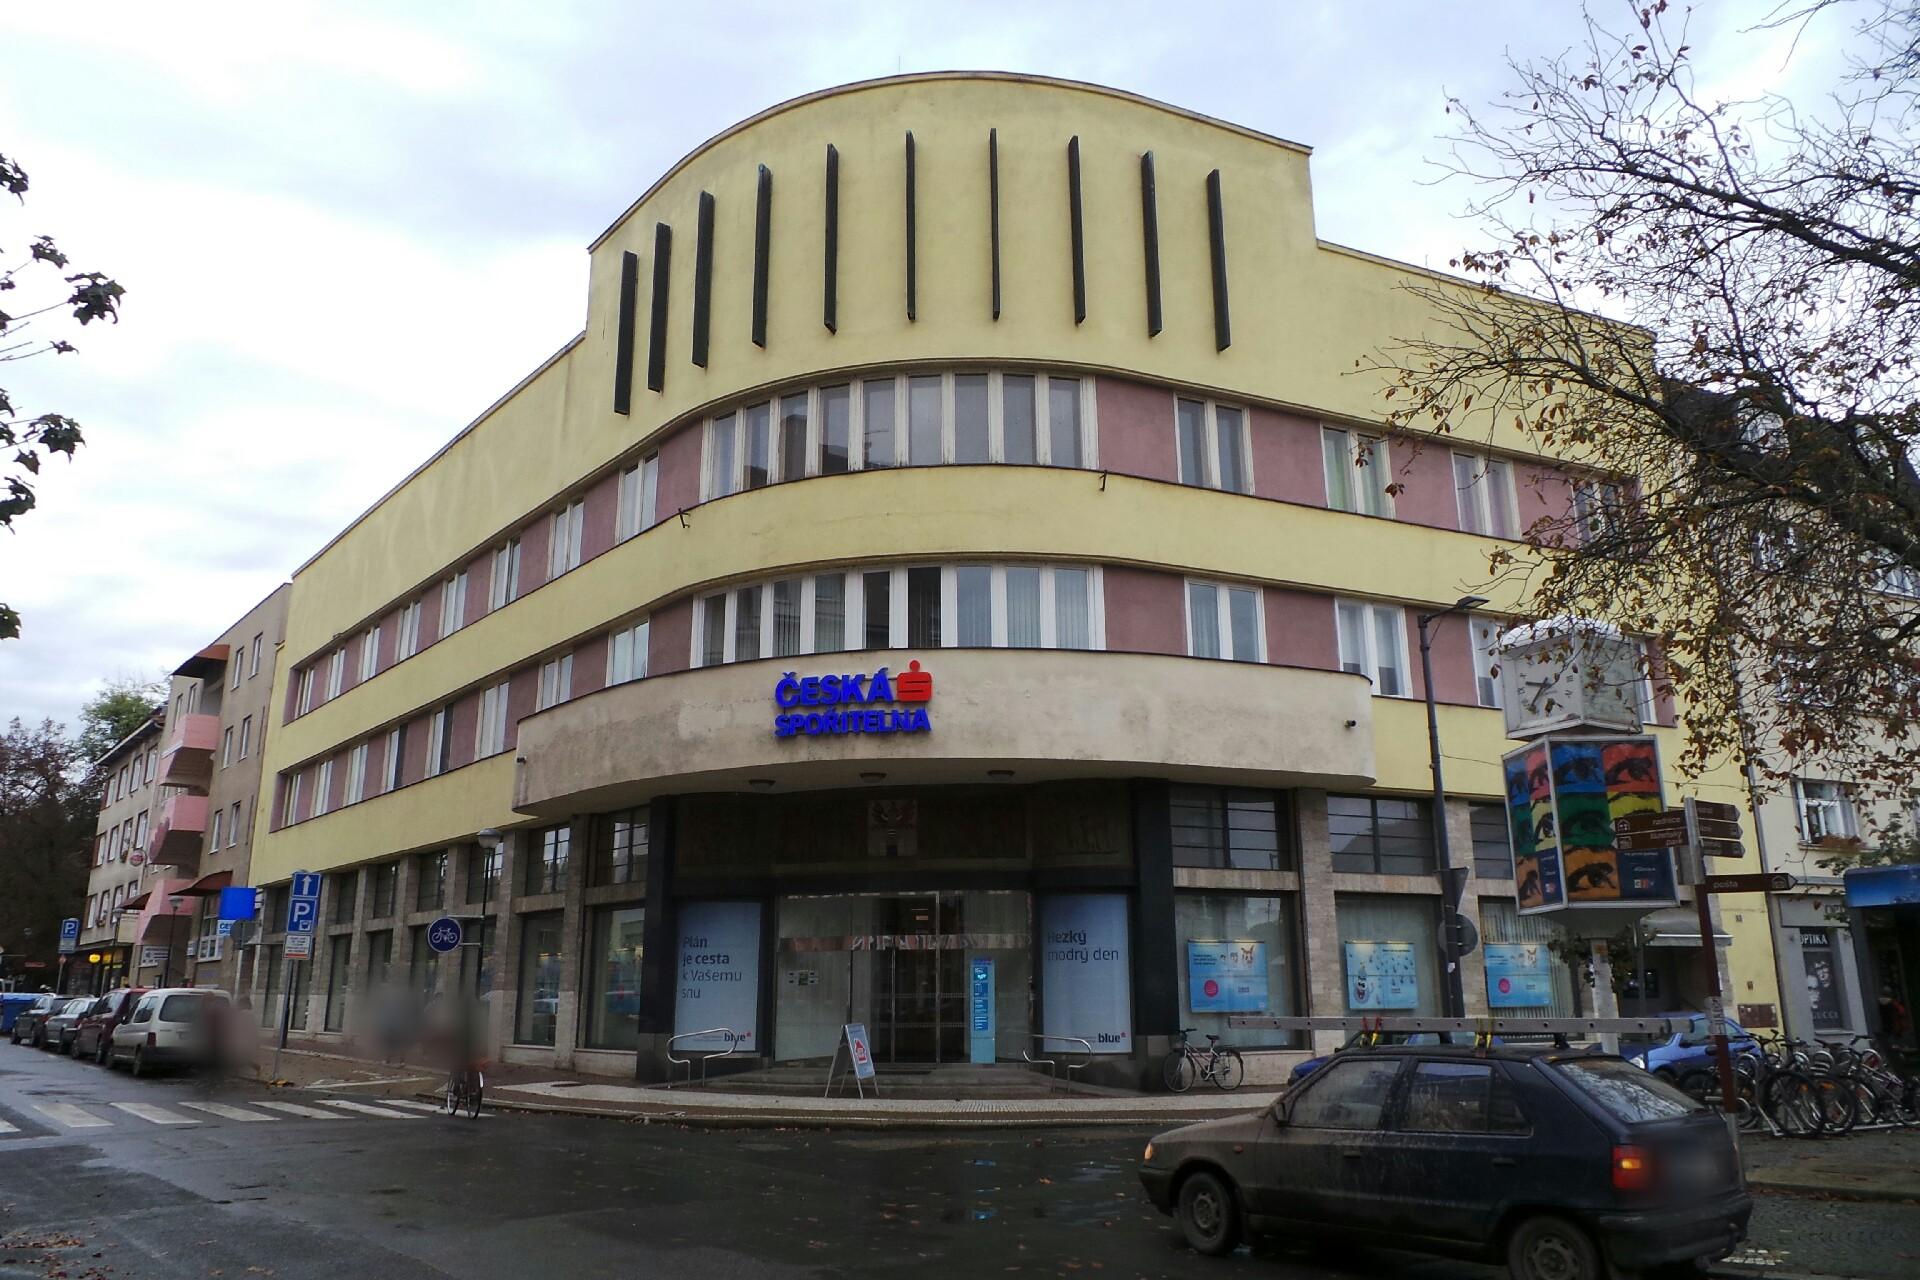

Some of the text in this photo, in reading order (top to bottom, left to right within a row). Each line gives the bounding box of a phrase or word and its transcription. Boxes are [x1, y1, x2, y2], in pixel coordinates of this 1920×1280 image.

[775, 667, 894, 708] ČESKÁ
[775, 706, 931, 737] SPOŘITELNA
[293, 902, 311, 922] P
[64, 922, 76, 934] P
[683, 935, 708, 948] Plán
[682, 953, 730, 967] je cesta
[1047, 947, 1119, 964] modrý den
[690, 968, 742, 981] Vašemu
[681, 988, 701, 999] snu
[724, 1032, 746, 1042] blue
[1098, 1032, 1121, 1043] blue
